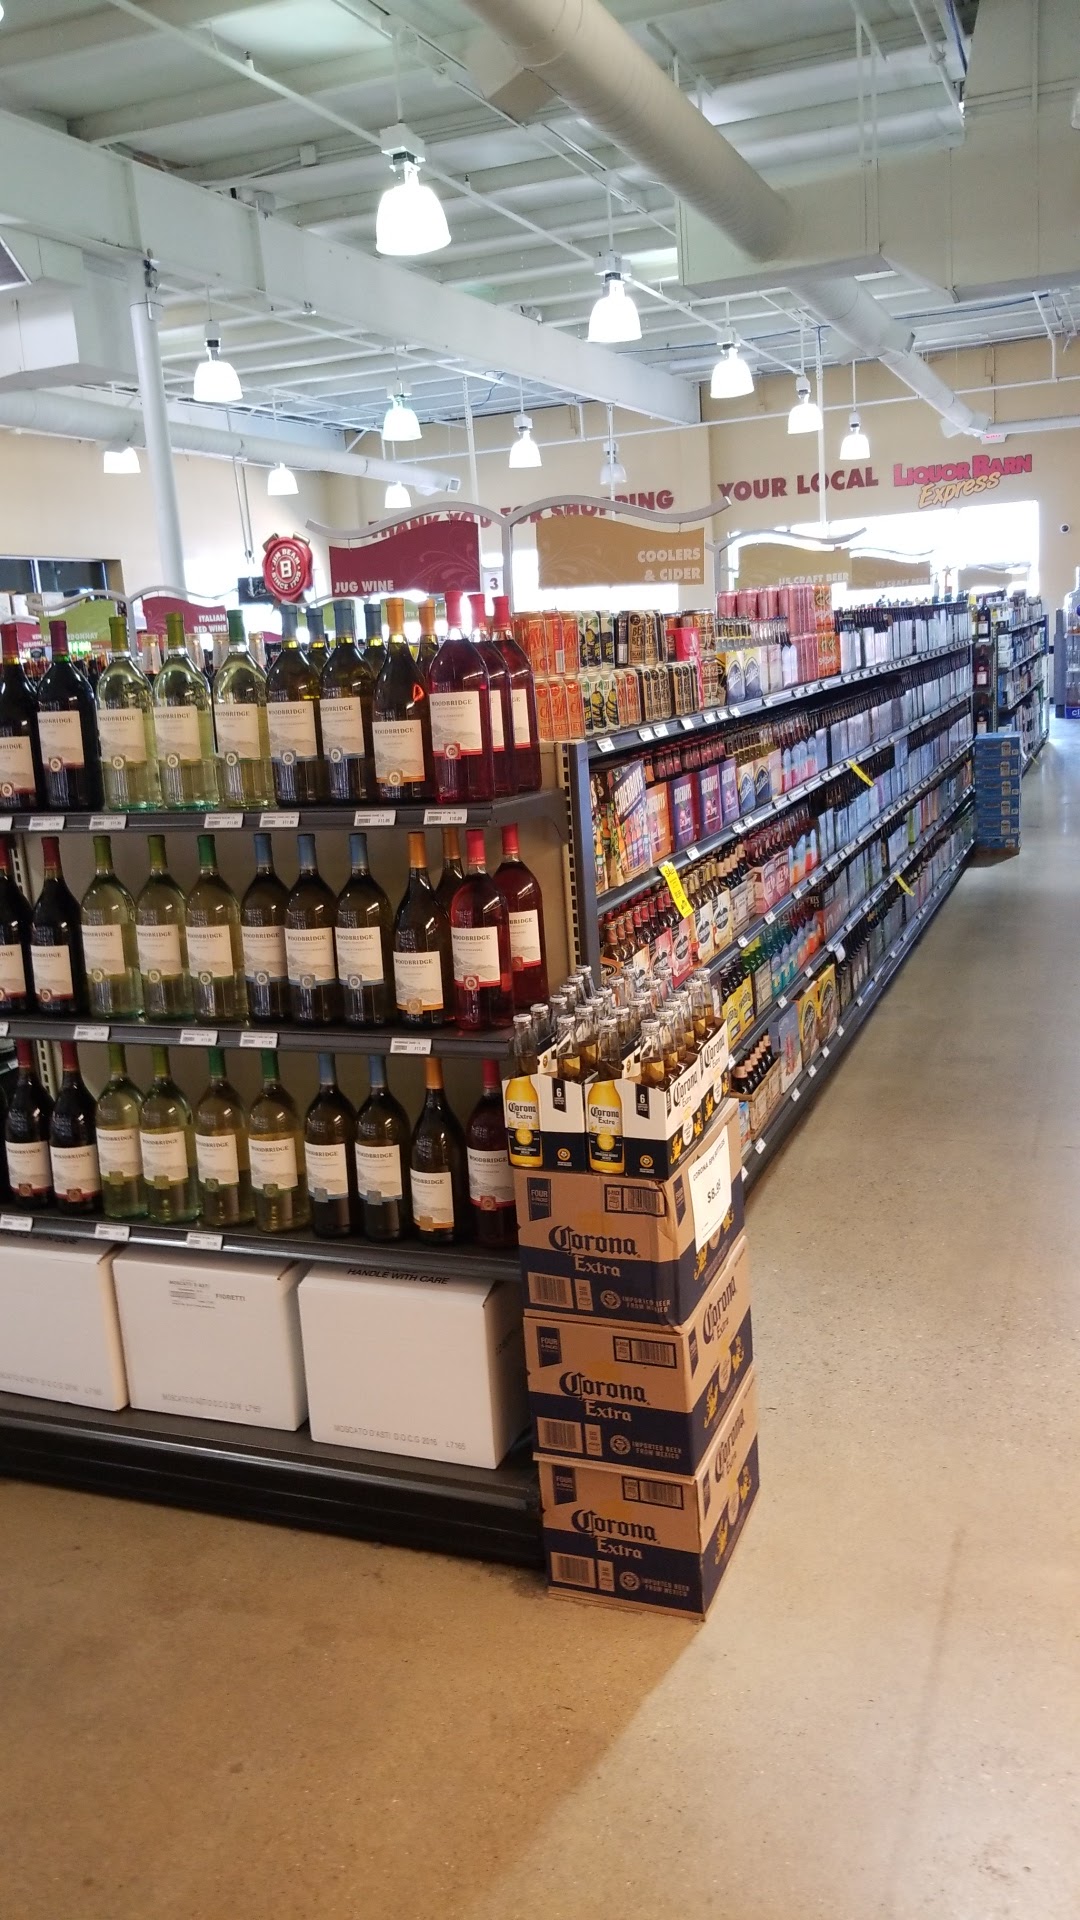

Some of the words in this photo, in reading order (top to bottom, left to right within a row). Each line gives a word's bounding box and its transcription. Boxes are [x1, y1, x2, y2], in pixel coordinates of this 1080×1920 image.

[893, 463, 972, 487] LIQUOR
[972, 453, 1033, 479] BARN
[717, 476, 788, 501] YOUR
[796, 467, 879, 494] LOCAL
[918, 471, 1001, 509] Express
[368, 514, 441, 539] HANK
[272, 551, 281, 565] JIM
[282, 548, 300, 565] BEAM
[637, 547, 701, 564] COOLERS
[280, 560, 292, 578] B
[644, 570, 655, 581] &
[659, 566, 701, 581] CIDER
[489, 577, 499, 590] 3
[793, 573, 823, 585] CRAFT
[826, 571, 849, 582] BEER
[334, 582, 359, 594] JUG
[361, 579, 394, 593] WINE
[199, 613, 226, 623] ITALIAN
[67, 631, 98, 640] DONNAY
[193, 625, 207, 634] RED
[209, 624, 228, 633] WINE
[432, 699, 472, 707] WOODBRIDGE
[375, 727, 415, 735] WOODBRIDGE
[510, 917, 533, 925] BRIDGE
[452, 934, 491, 942] WOODBRIDGE
[556, 1087, 562, 1098] 6
[673, 1070, 698, 1108] Corona
[640, 1093, 646, 1104] 6
[508, 1102, 536, 1114] Corona
[590, 1106, 620, 1118] Corona
[516, 1112, 533, 1120] Extra
[598, 1116, 616, 1125] Extra
[531, 1188, 549, 1198] FOUR
[548, 1225, 639, 1256] Corona
[574, 1254, 621, 1278] Extra
[347, 1268, 390, 1279] HANDLE
[391, 1272, 418, 1282] WITH
[419, 1275, 450, 1285] CARE
[703, 1276, 737, 1345] Corona
[540, 1336, 558, 1346] FOUR
[559, 1371, 648, 1403] Corona
[585, 1400, 633, 1422] Extra
[334, 1424, 368, 1436] MOSCATO
[571, 1508, 657, 1541] Corona
[596, 1537, 643, 1560] Extra
